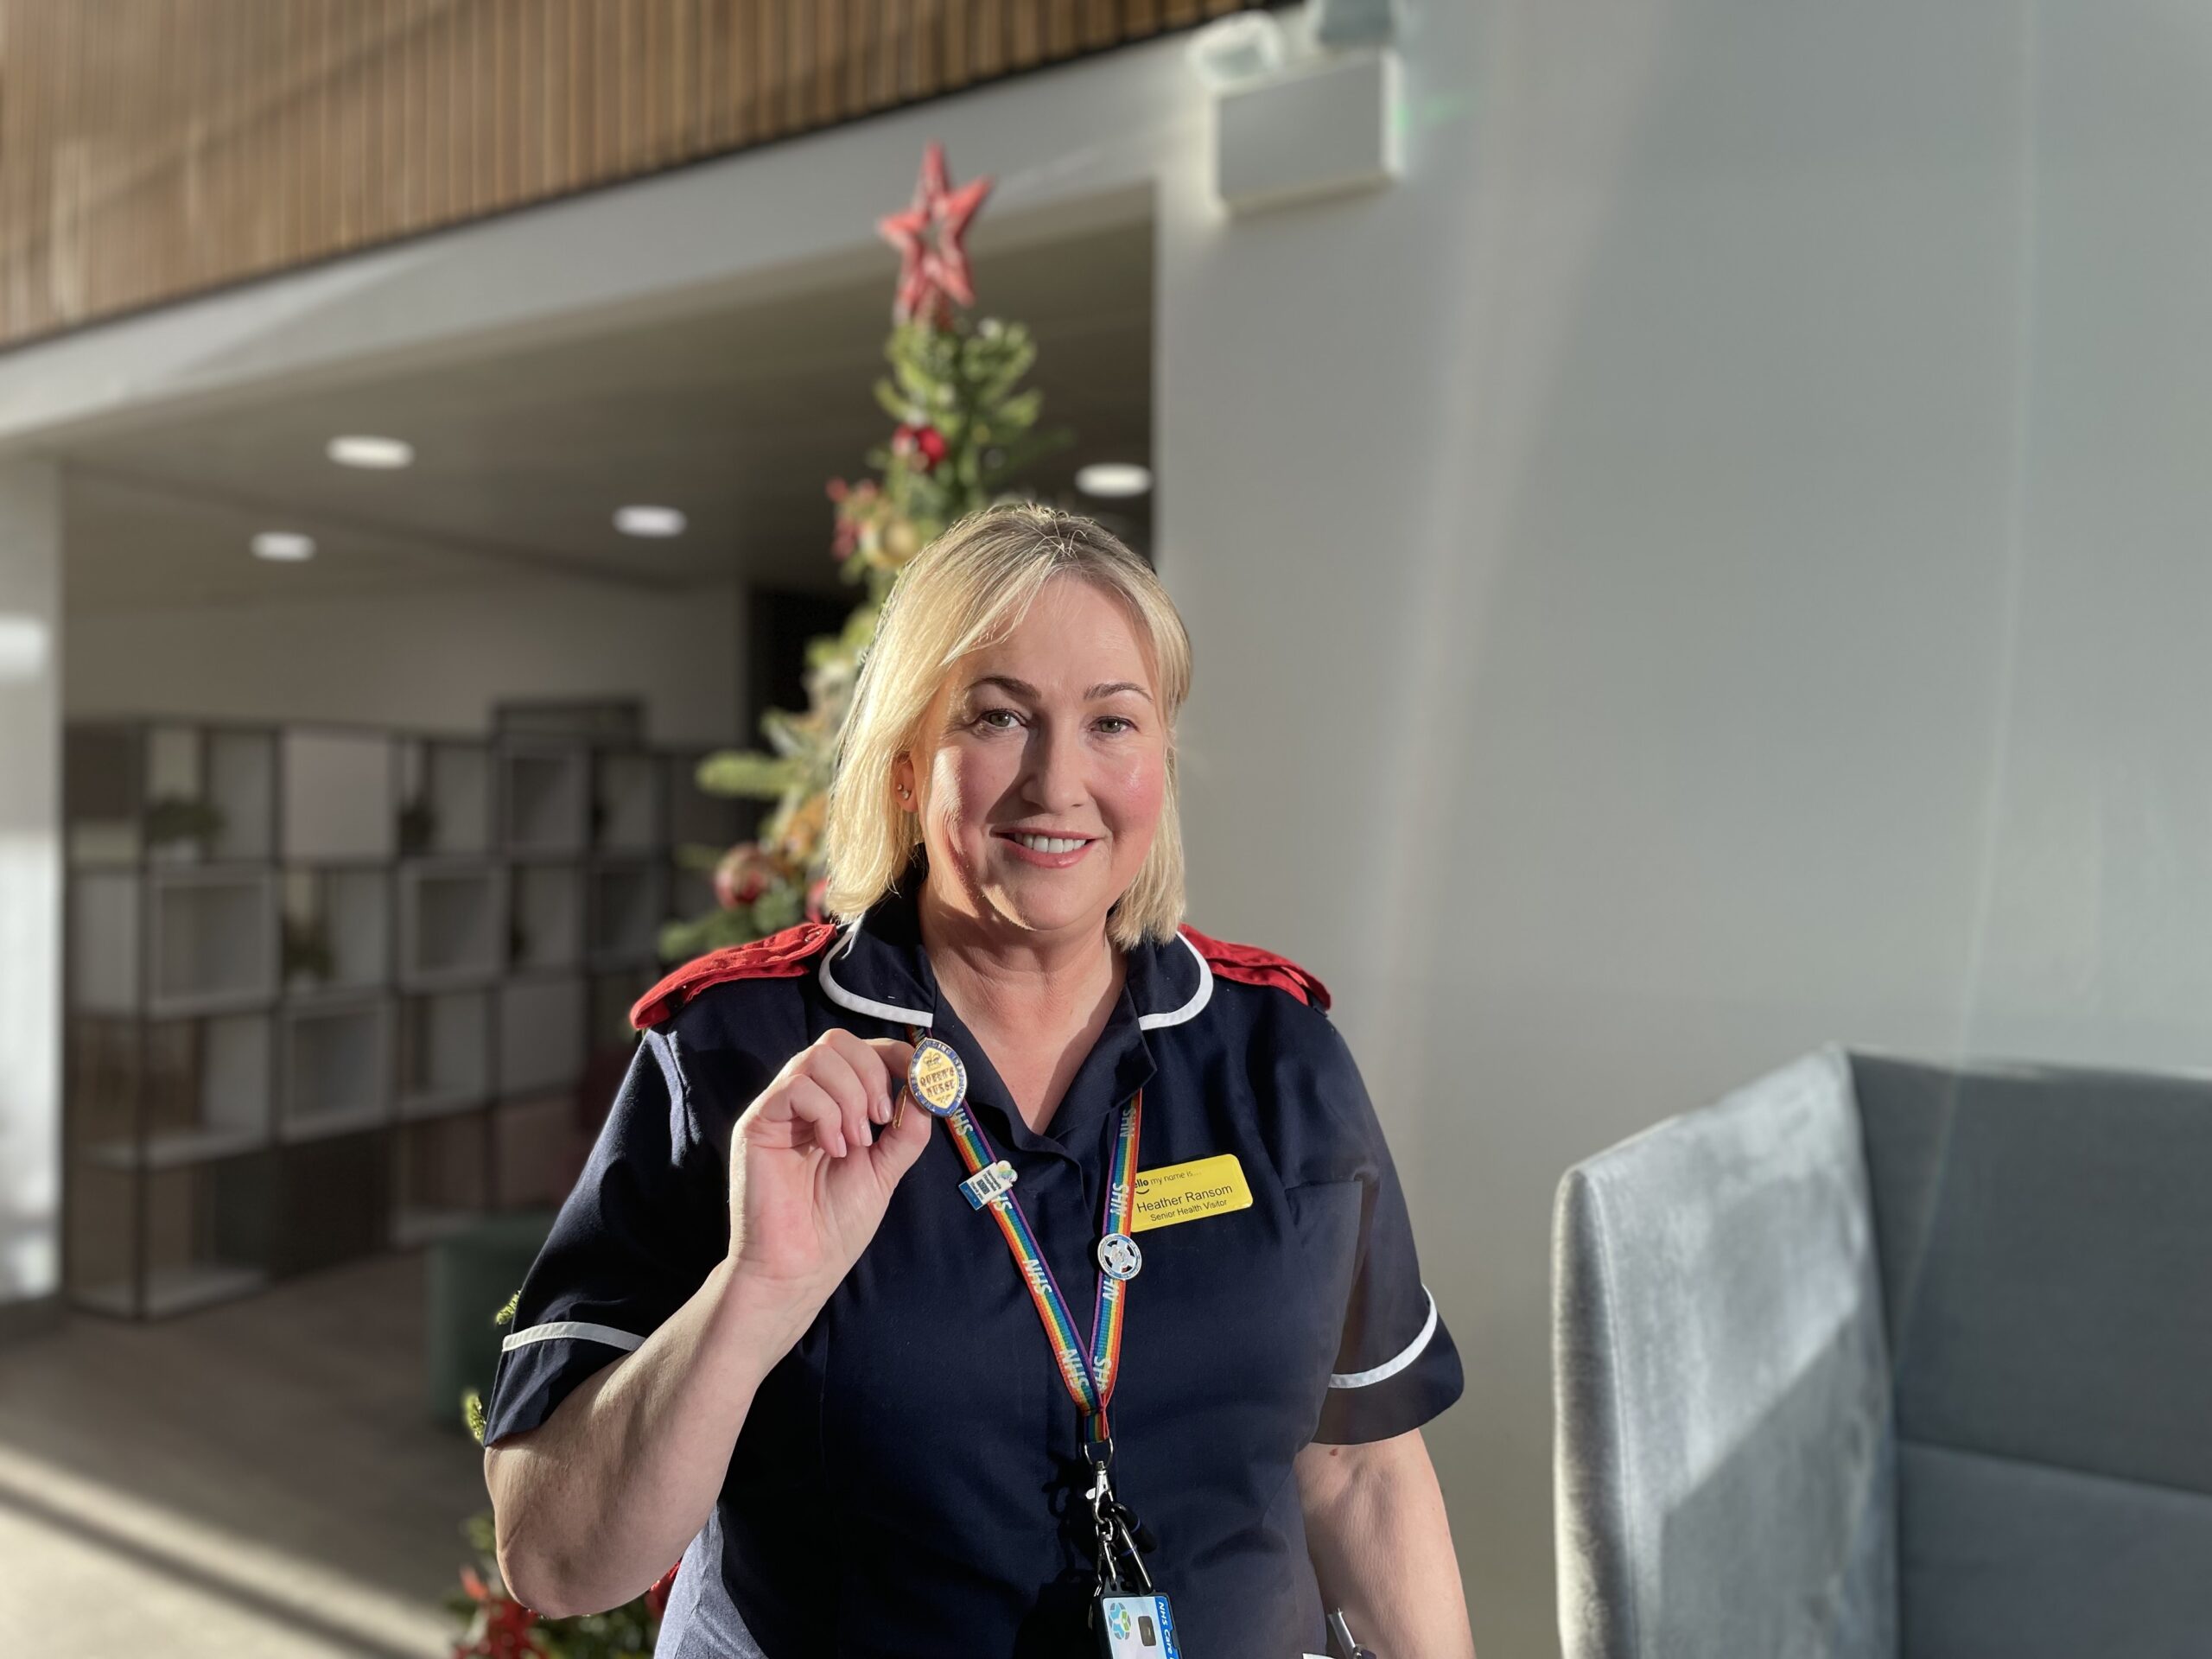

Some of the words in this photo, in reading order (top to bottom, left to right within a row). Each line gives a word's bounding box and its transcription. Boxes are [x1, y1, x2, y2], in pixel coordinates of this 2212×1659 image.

[925, 1079, 956, 1098] NURSE
[1121, 1108, 1136, 1137] NHS
[1135, 1179, 1149, 1189] ello
[1150, 1176, 1163, 1185] my
[1164, 1171, 1185, 1182] name
[1110, 1182, 1129, 1217] NHS
[1136, 1196, 1182, 1213] Heather
[1185, 1185, 1233, 1203] Ransom
[1150, 1210, 1176, 1222] Senior
[1177, 1205, 1203, 1217] Health
[1204, 1198, 1227, 1211] Visitor
[1023, 1259, 1052, 1294] NHS
[1103, 1278, 1120, 1303] NH
[1060, 1349, 1090, 1389] NHS
[1159, 1602, 1167, 1626] NHS
[1164, 1629, 1173, 1655] Care
